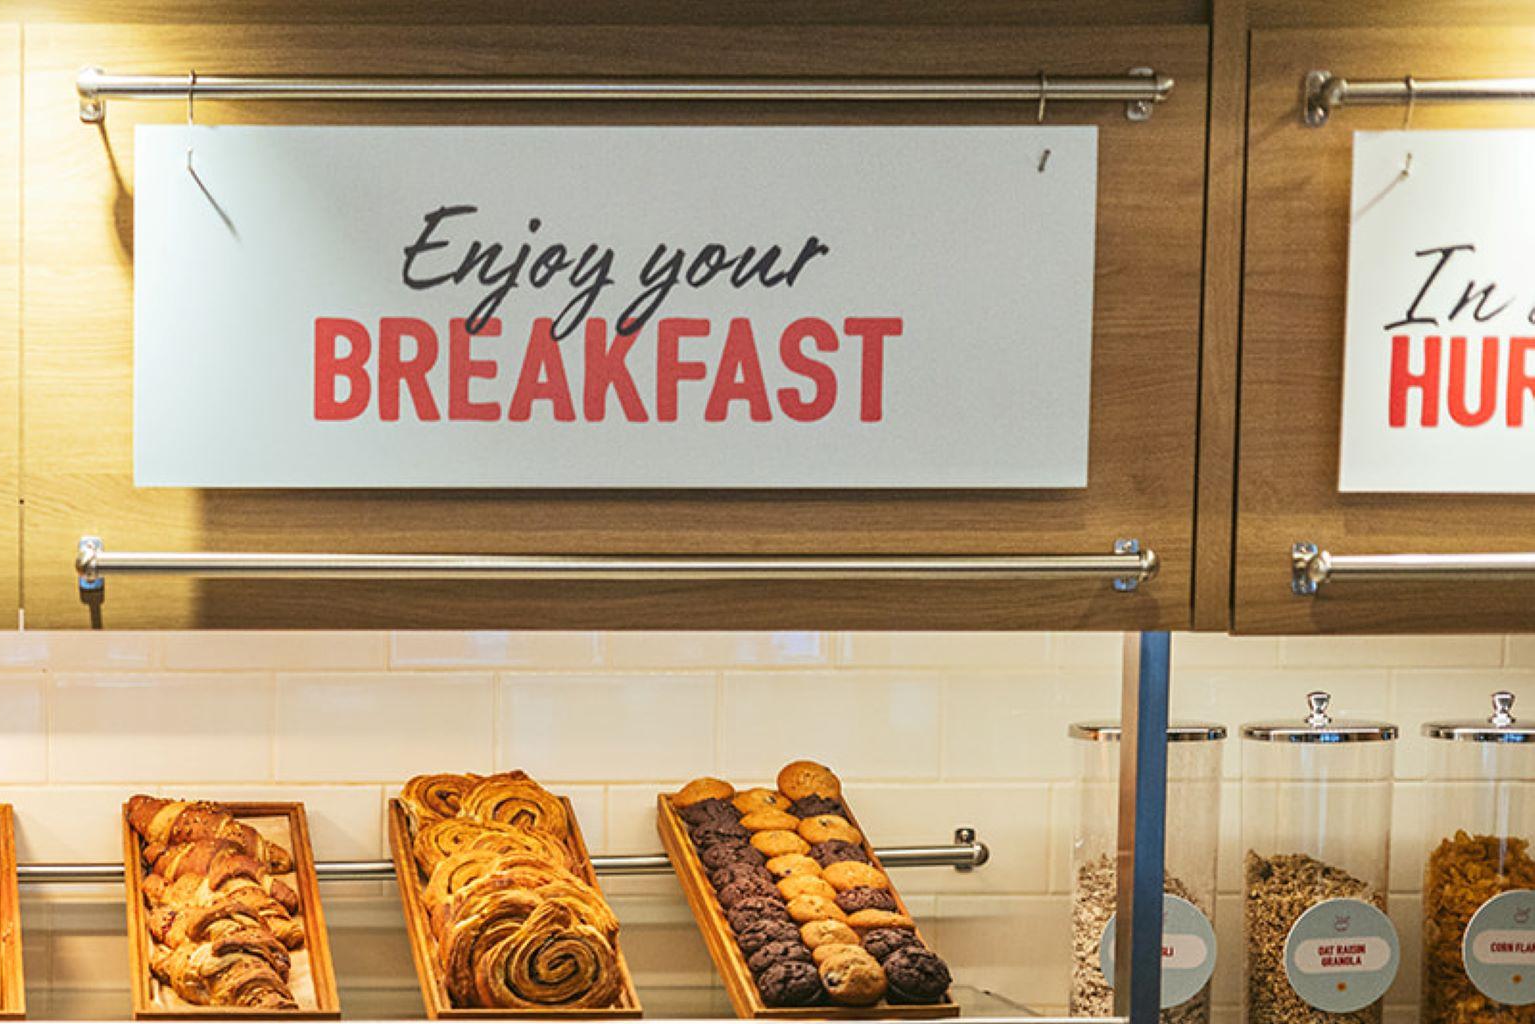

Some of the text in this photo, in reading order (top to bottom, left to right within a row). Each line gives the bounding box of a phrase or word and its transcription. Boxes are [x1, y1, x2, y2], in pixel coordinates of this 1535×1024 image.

[401, 205, 829, 341] Enjoy your
[1384, 244, 1514, 330] In
[313, 316, 904, 423] BREAKFAST
[1317, 945, 1335, 956] OAT
[1321, 956, 1362, 967] GRANOLA
[1490, 942, 1514, 953] CORN
